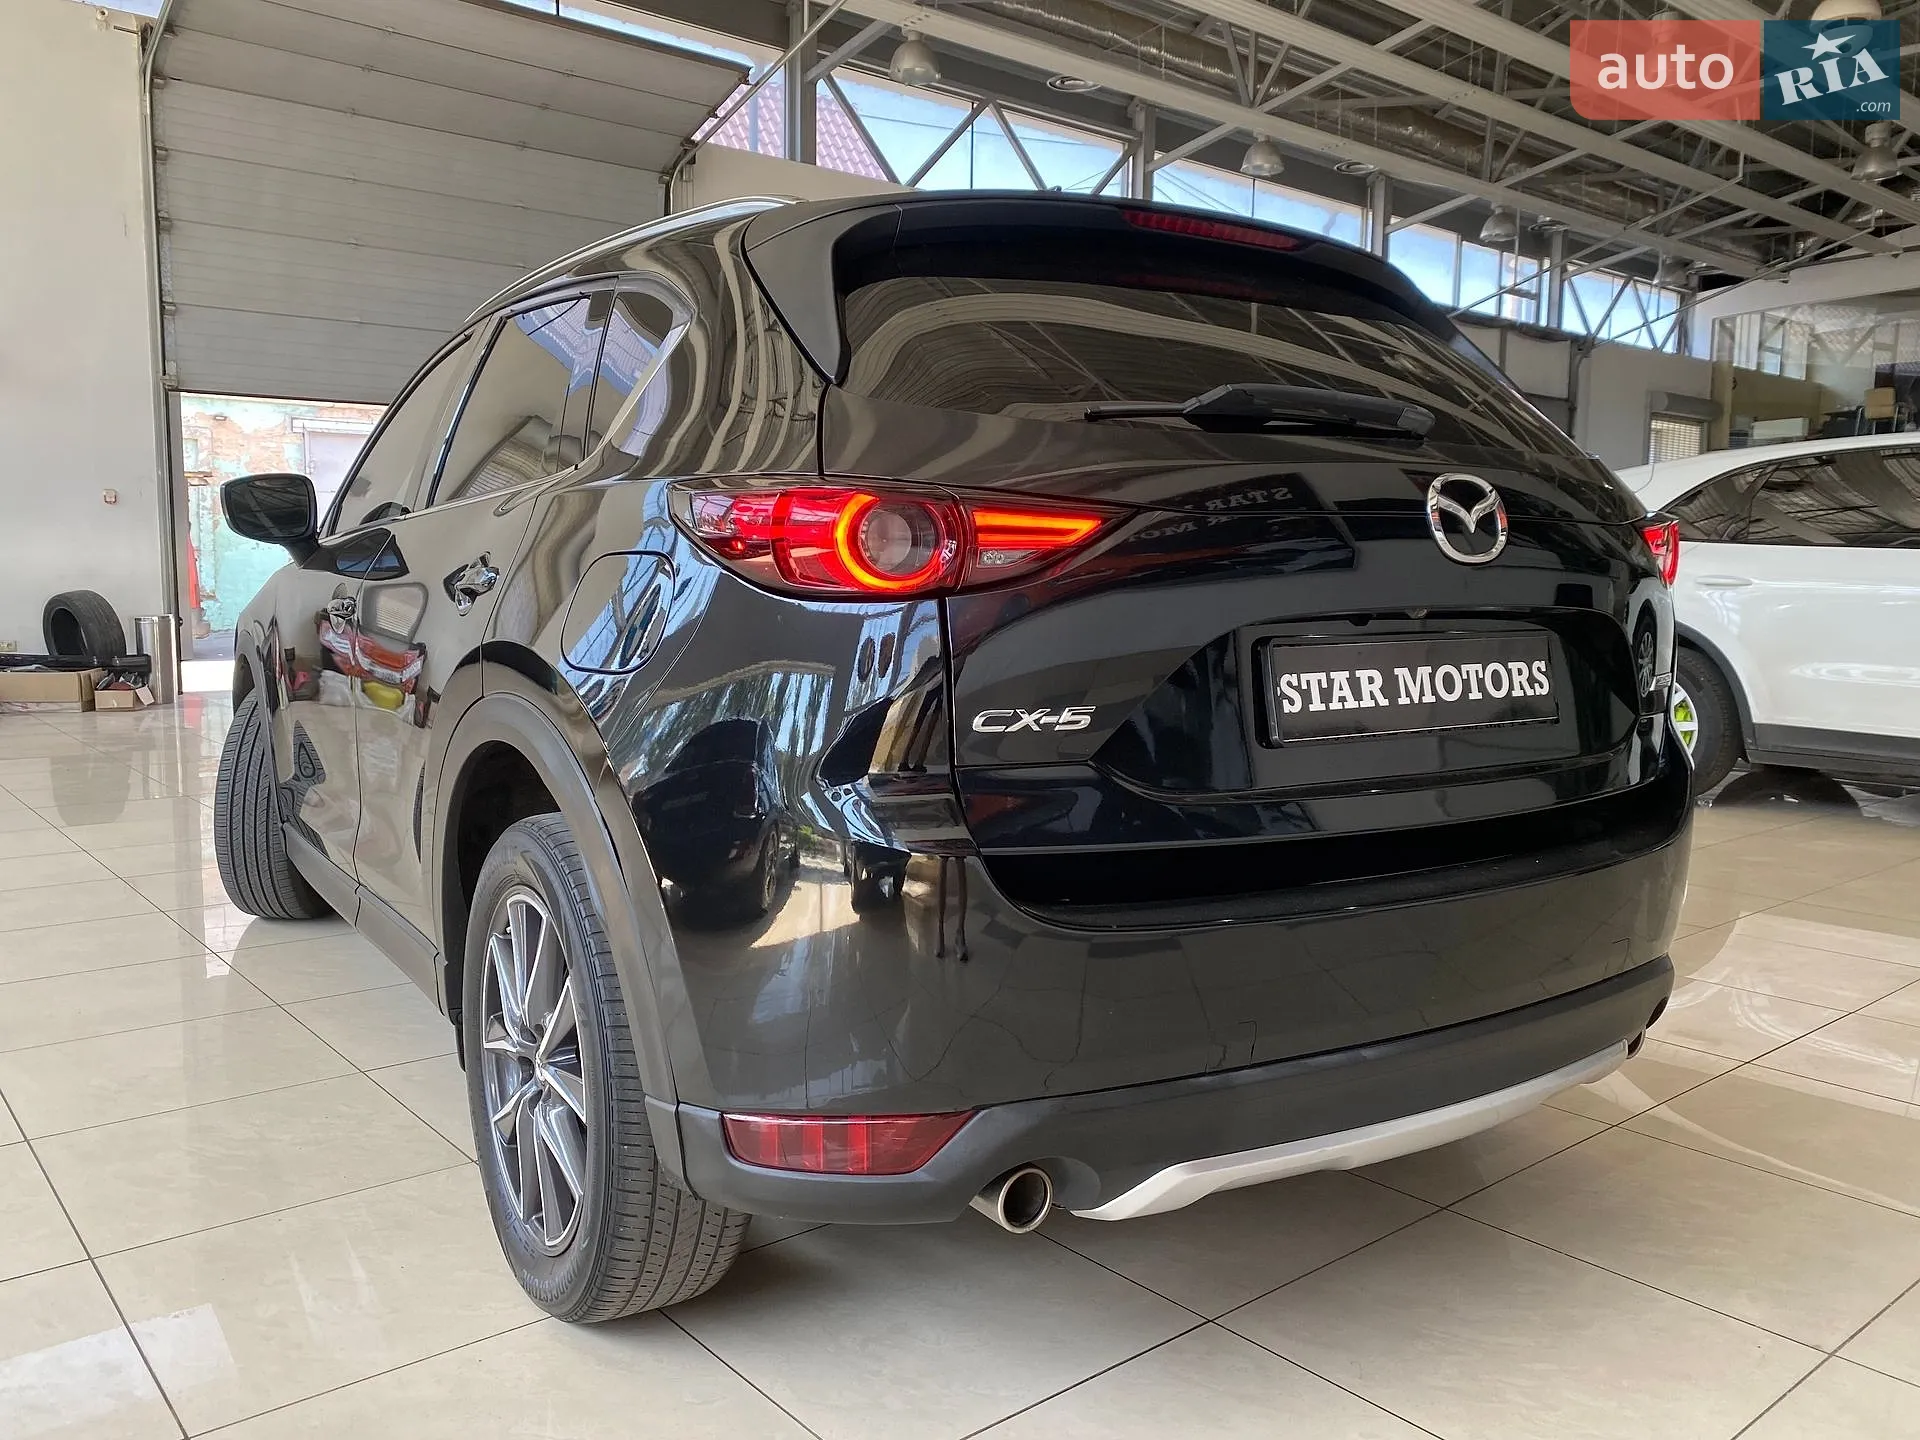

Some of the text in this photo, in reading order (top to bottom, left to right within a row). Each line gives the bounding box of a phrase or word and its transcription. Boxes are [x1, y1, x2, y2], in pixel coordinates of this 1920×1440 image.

[1279, 660, 1550, 713] STAR MOTORS
[972, 706, 1096, 733] CX-5
